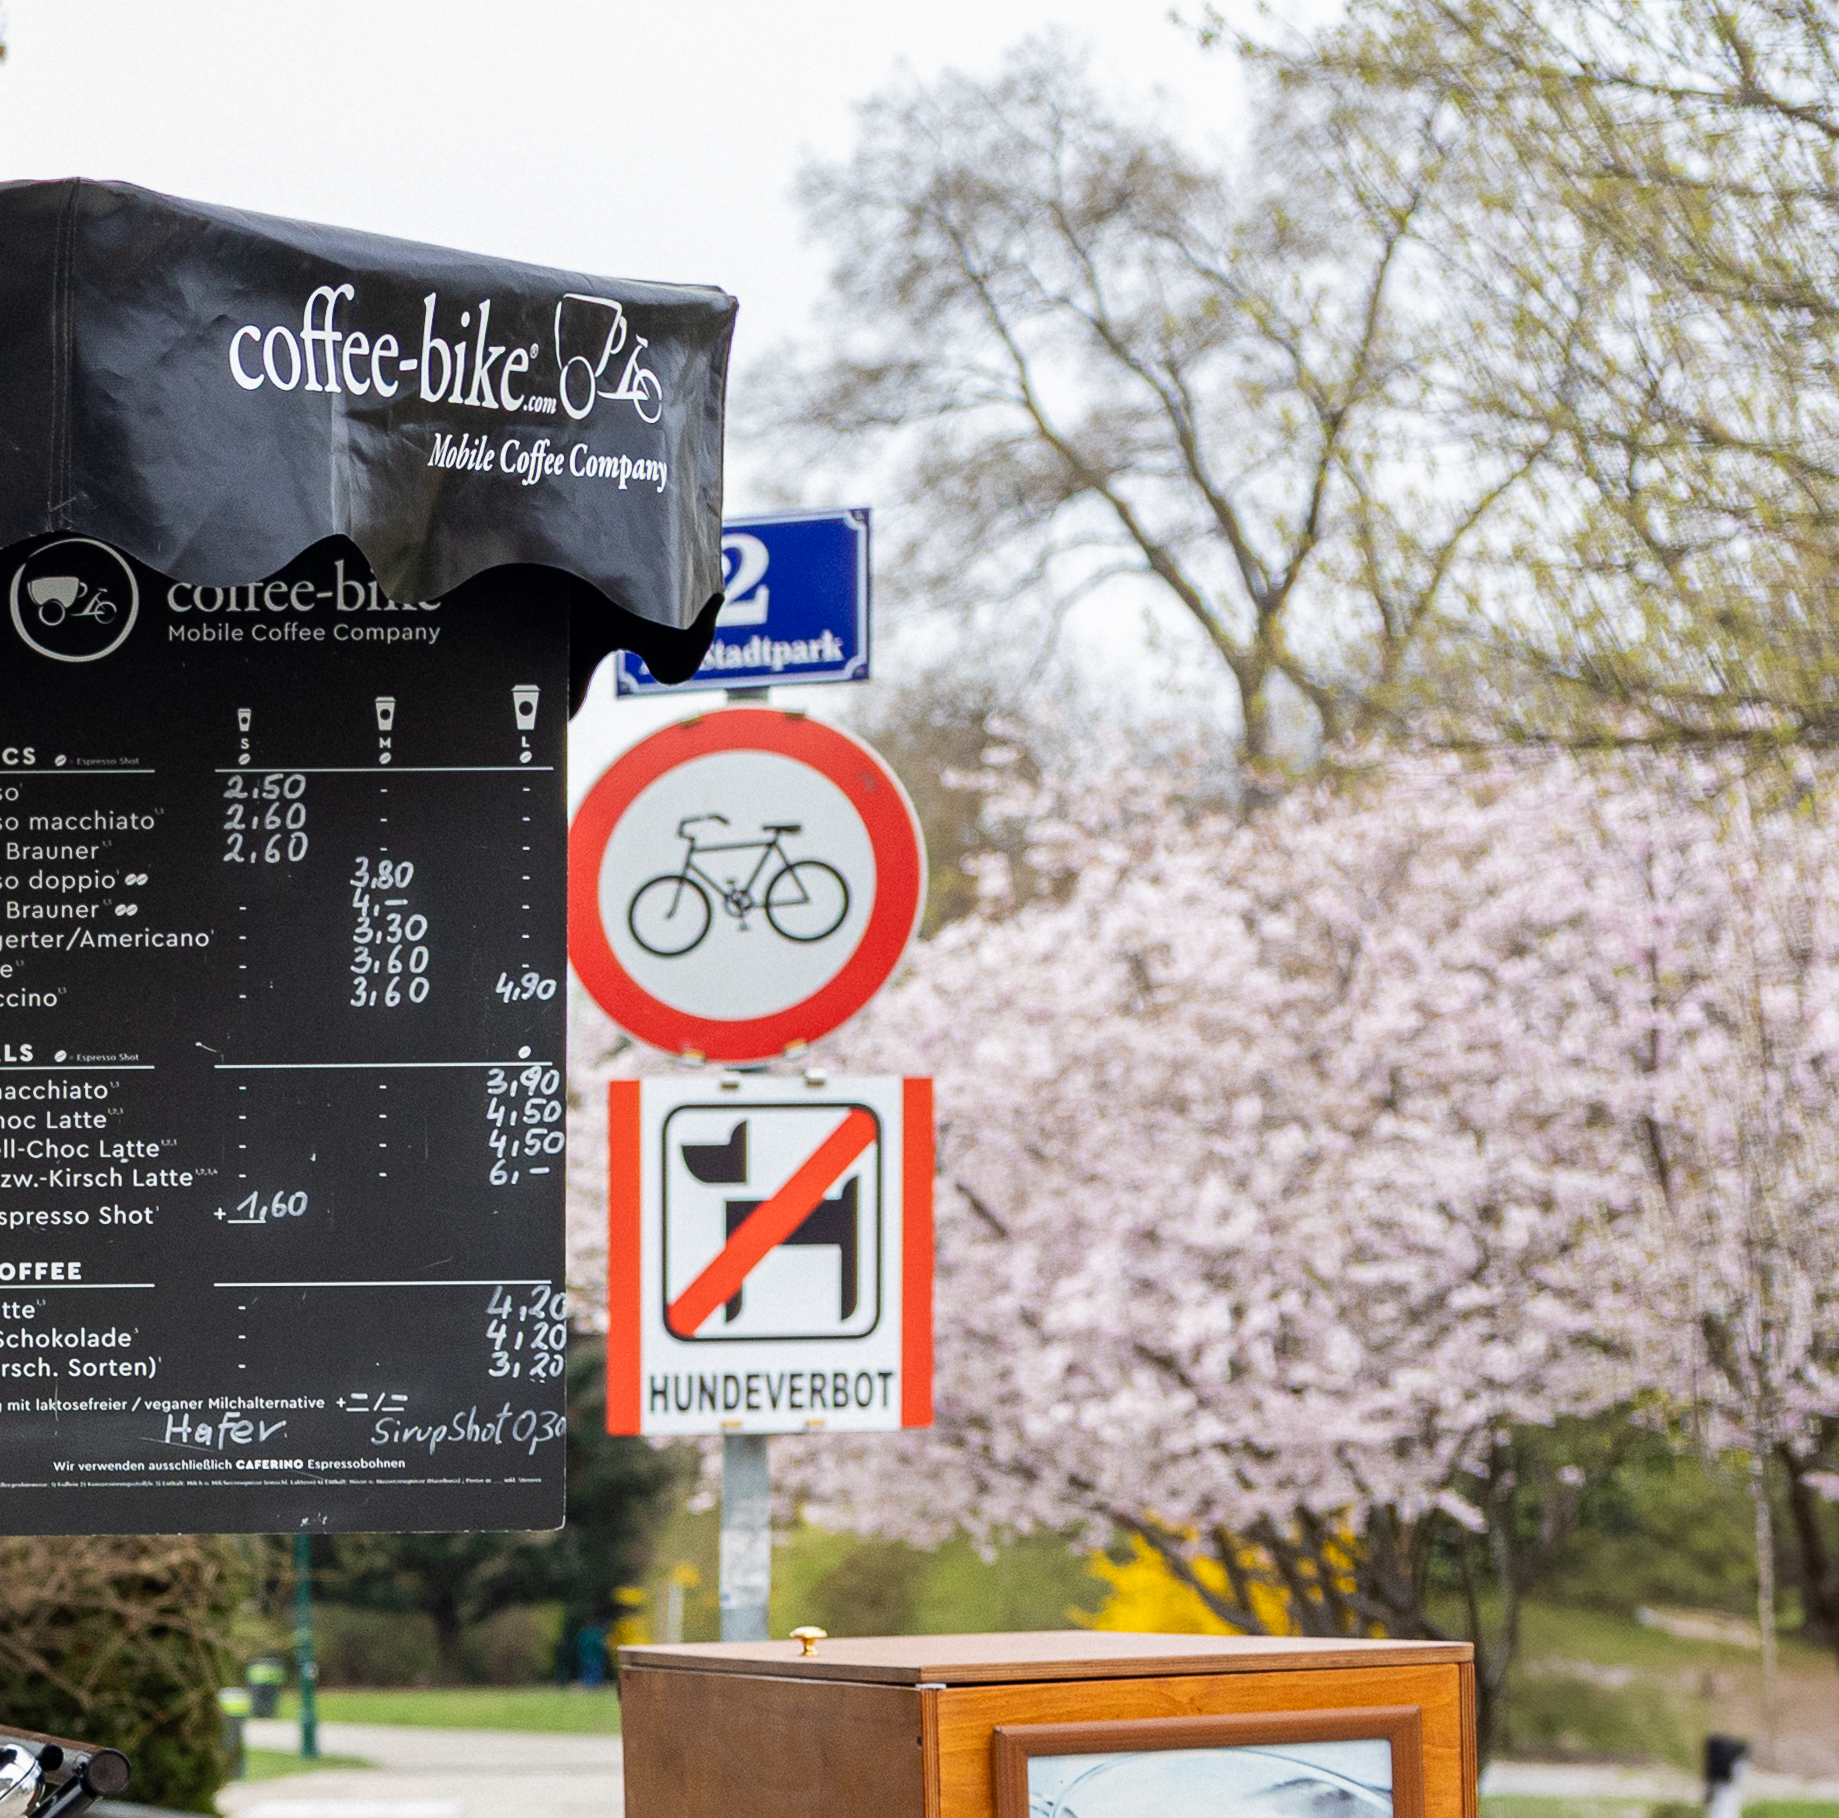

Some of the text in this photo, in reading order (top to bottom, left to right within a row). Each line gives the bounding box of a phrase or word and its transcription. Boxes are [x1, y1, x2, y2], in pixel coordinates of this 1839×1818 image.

[427, 433, 668, 493] Mobile Coffee Company
[167, 559, 441, 612] coee-bi
[716, 533, 769, 627] 2
[169, 622, 441, 644] Mobile Coffee Company
[223, 775, 307, 800] 2,50
[29, 809, 155, 831] macchiato
[223, 804, 307, 831] 2,60
[6, 841, 100, 861] Brauner
[223, 834, 308, 864] 2,60
[28, 869, 116, 894] doppio
[351, 860, 413, 889] 3,80
[6, 900, 100, 920] Brauner
[353, 915, 428, 944] 3,30
[351, 946, 429, 974] 3,60
[351, 978, 429, 1006] 3,60
[495, 972, 557, 1002] 4,90
[485, 1069, 559, 1099] 3,90
[46, 1109, 111, 1130] Latte
[487, 1100, 563, 1128] 4,50
[99, 1139, 165, 1164] Latte
[488, 1130, 565, 1158] 4,50
[132, 1168, 199, 1188] Latte
[98, 1204, 154, 1225] Shot
[235, 1191, 309, 1221] 1,60
[487, 1285, 567, 1320] 4,20
[487, 1322, 567, 1350] 4,20
[68, 1356, 162, 1379] Sorten)
[488, 1351, 564, 1378] 3,20
[7, 1399, 31, 1411] mit
[36, 1398, 127, 1412] laktosefreier
[145, 1399, 203, 1415] veganer
[208, 1395, 325, 1411] Milchalternative
[650, 1371, 894, 1412] HUNDEVERBOT
[54, 1457, 405, 1472] Wir verwenden ausschließlich CAFERINO Espressobohnen
